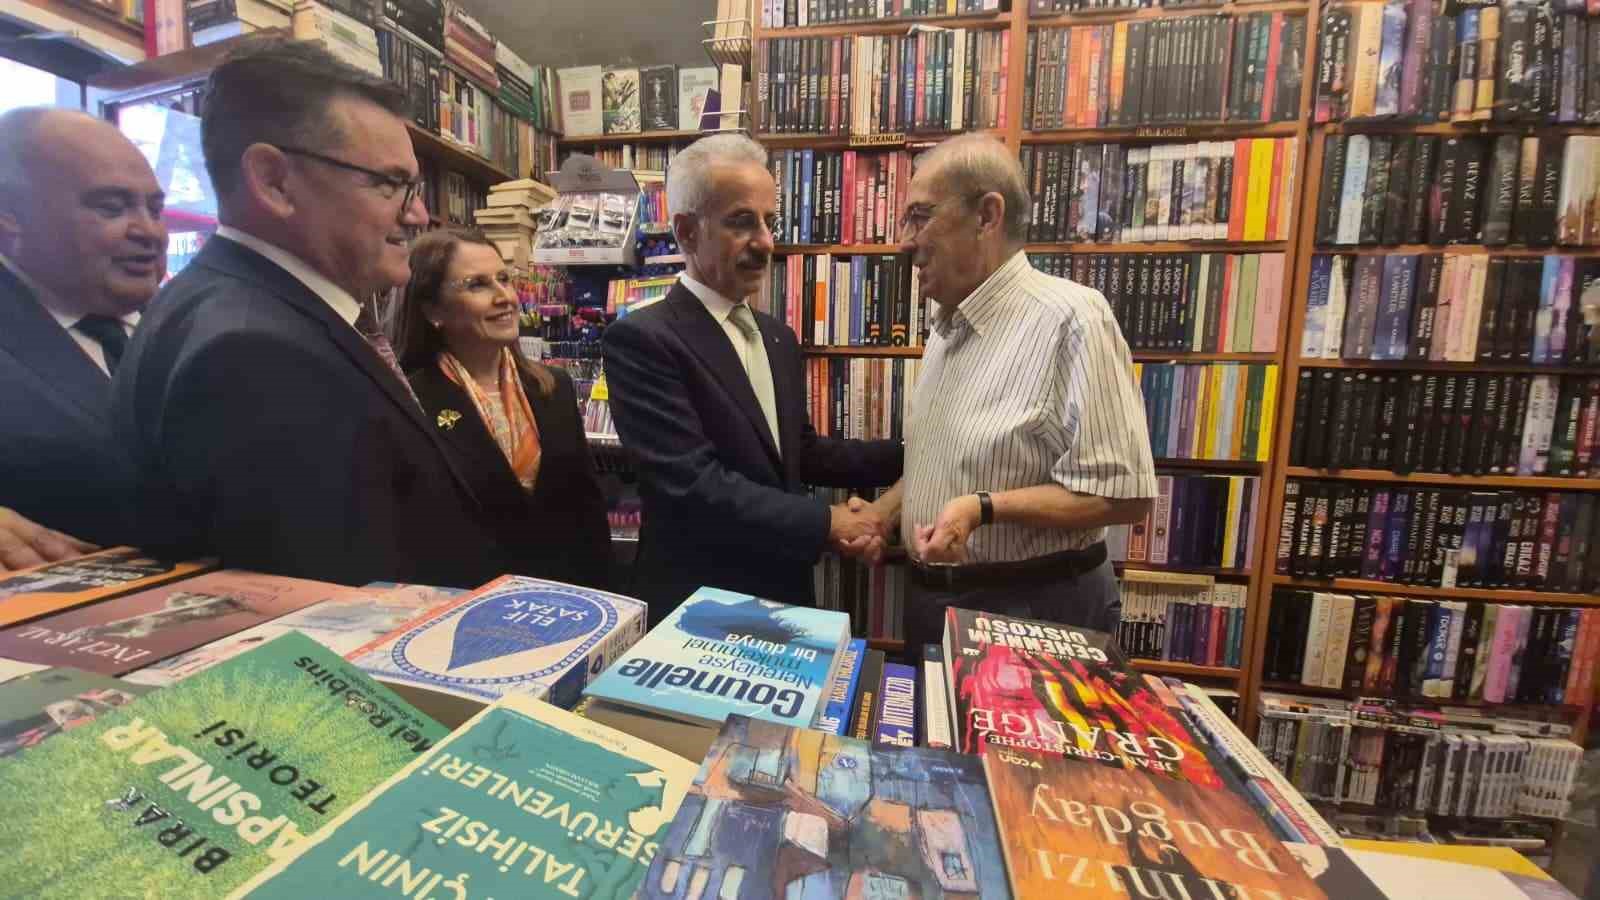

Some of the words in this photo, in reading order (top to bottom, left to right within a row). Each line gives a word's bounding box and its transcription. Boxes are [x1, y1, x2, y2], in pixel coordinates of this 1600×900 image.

[681, 637, 803, 671] mükemmel
[698, 652, 815, 691] Neredeyse
[723, 632, 787, 657] dünya
[791, 646, 818, 663] bir
[967, 627, 1110, 664] CEHENNEM
[618, 656, 806, 719] Gounelle
[972, 706, 1186, 762] GRANGÉ
[990, 733, 1177, 773] JEAN-CHRISTOPHE
[99, 718, 312, 863] APSINLAR
[193, 719, 338, 816] TEORİSİ
[106, 786, 233, 874] BIRAK
[421, 752, 661, 867] SERÜVENLERİ
[1031, 783, 1289, 877] Buğday
[422, 806, 588, 898] TALİHSİZ
